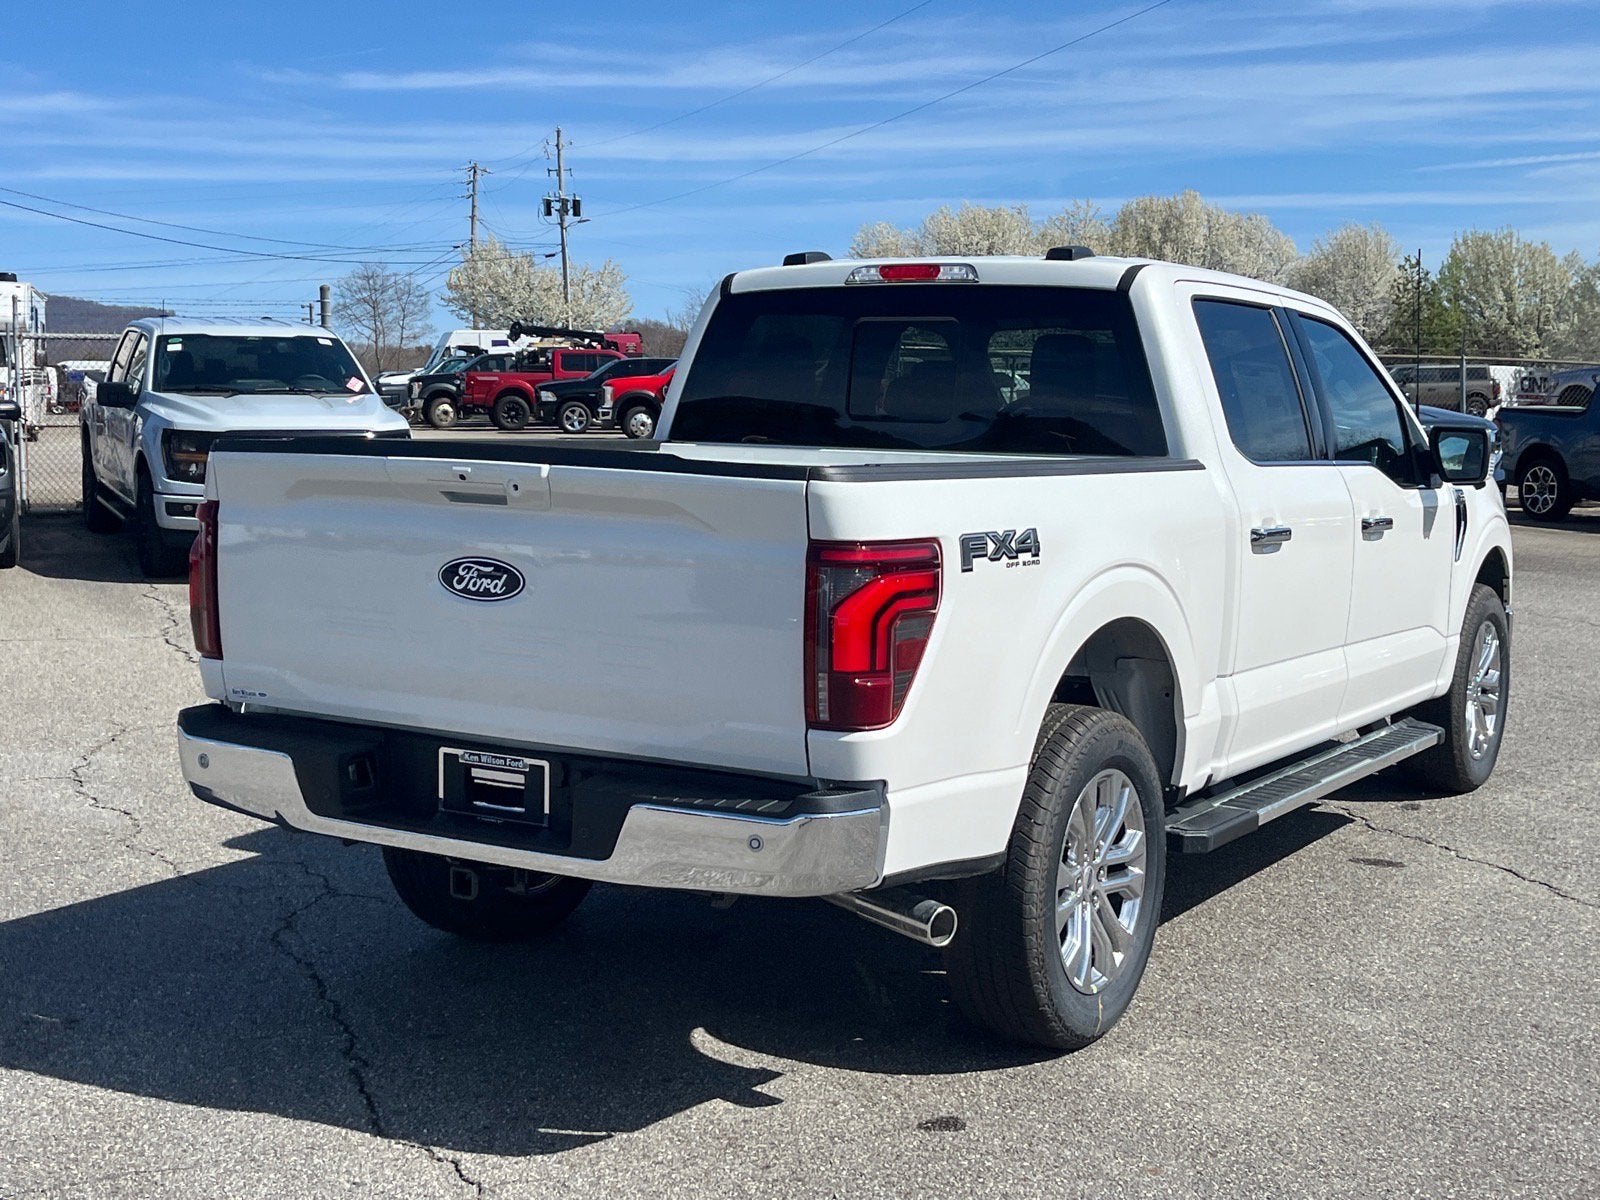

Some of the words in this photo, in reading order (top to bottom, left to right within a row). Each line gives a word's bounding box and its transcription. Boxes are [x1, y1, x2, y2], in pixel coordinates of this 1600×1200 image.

[959, 528, 1040, 573] FX4
[1006, 561, 1020, 569] OFF
[1022, 559, 1041, 567] ROAD
[453, 563, 508, 594] Ford
[464, 752, 479, 762] Ken
[480, 754, 505, 766] Wilson
[506, 758, 523, 768] Ford
